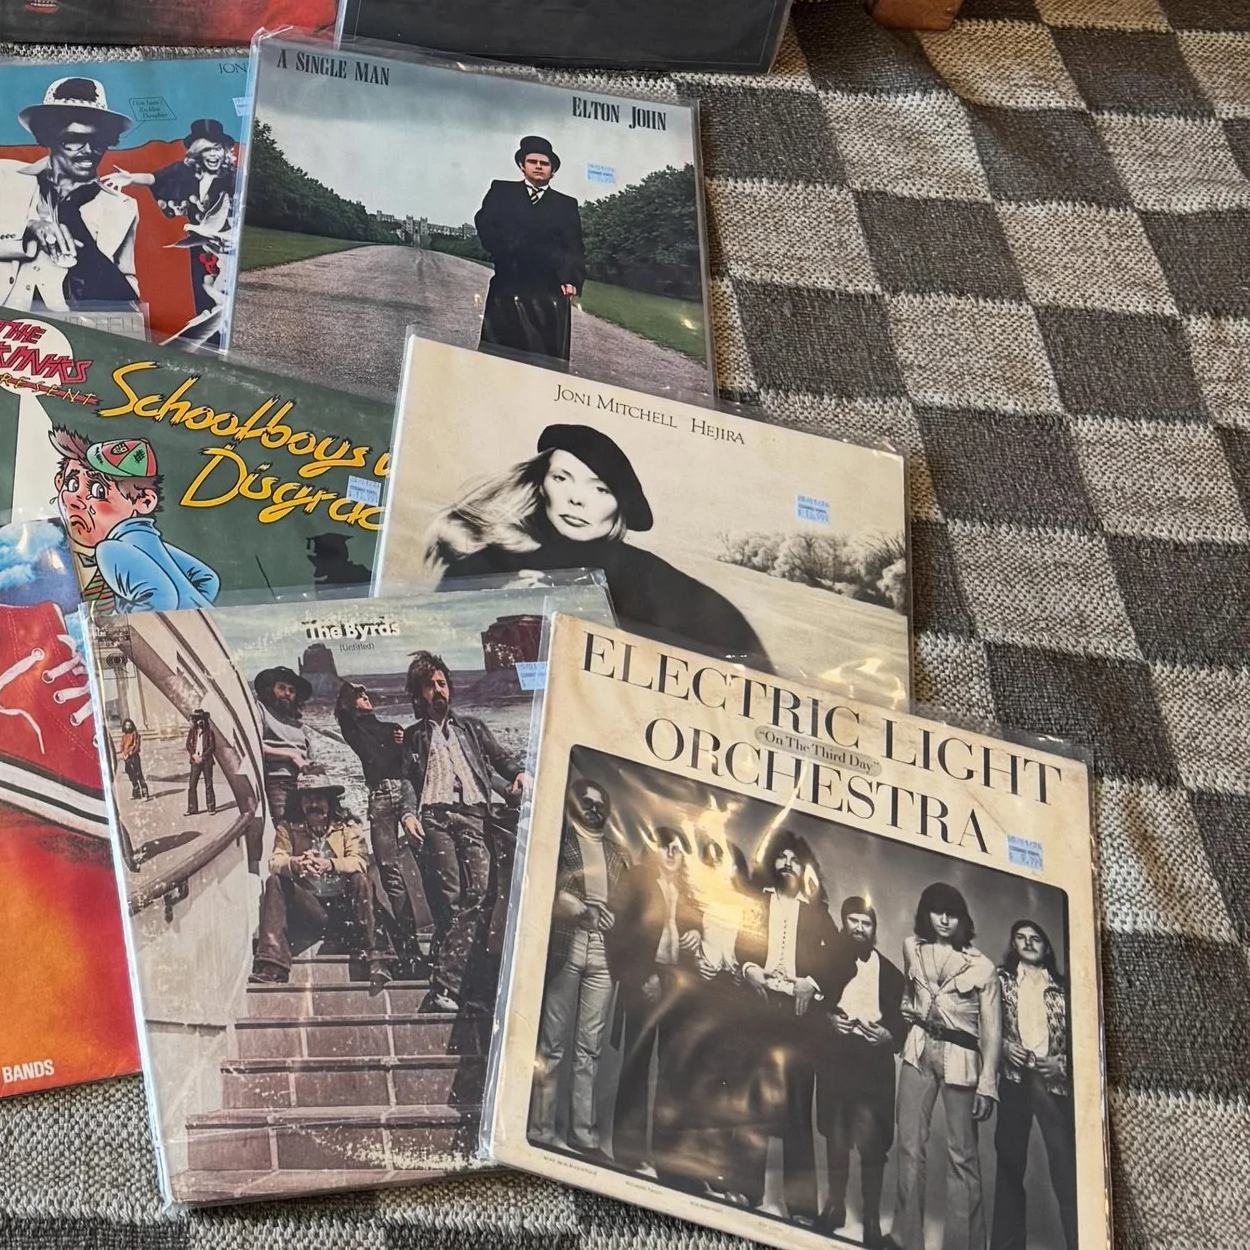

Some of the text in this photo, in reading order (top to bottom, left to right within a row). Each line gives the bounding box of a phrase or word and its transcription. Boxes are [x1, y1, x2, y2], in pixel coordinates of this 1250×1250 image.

[276, 49, 390, 87] A SINGLE MAN
[571, 96, 667, 132] ELTON JOHN
[99, 361, 371, 470] Schoolboys
[553, 383, 746, 445] JONI MITCHELL HEJIRA
[306, 622, 401, 642] The Byrds
[339, 642, 375, 652] (Untitled)
[581, 630, 1061, 806] ELECTRIC LIGHT
[787, 734, 811, 755] The
[812, 740, 847, 763] Third
[645, 717, 992, 856] ORCHESTRA
[1, 1059, 56, 1084] BANDS
